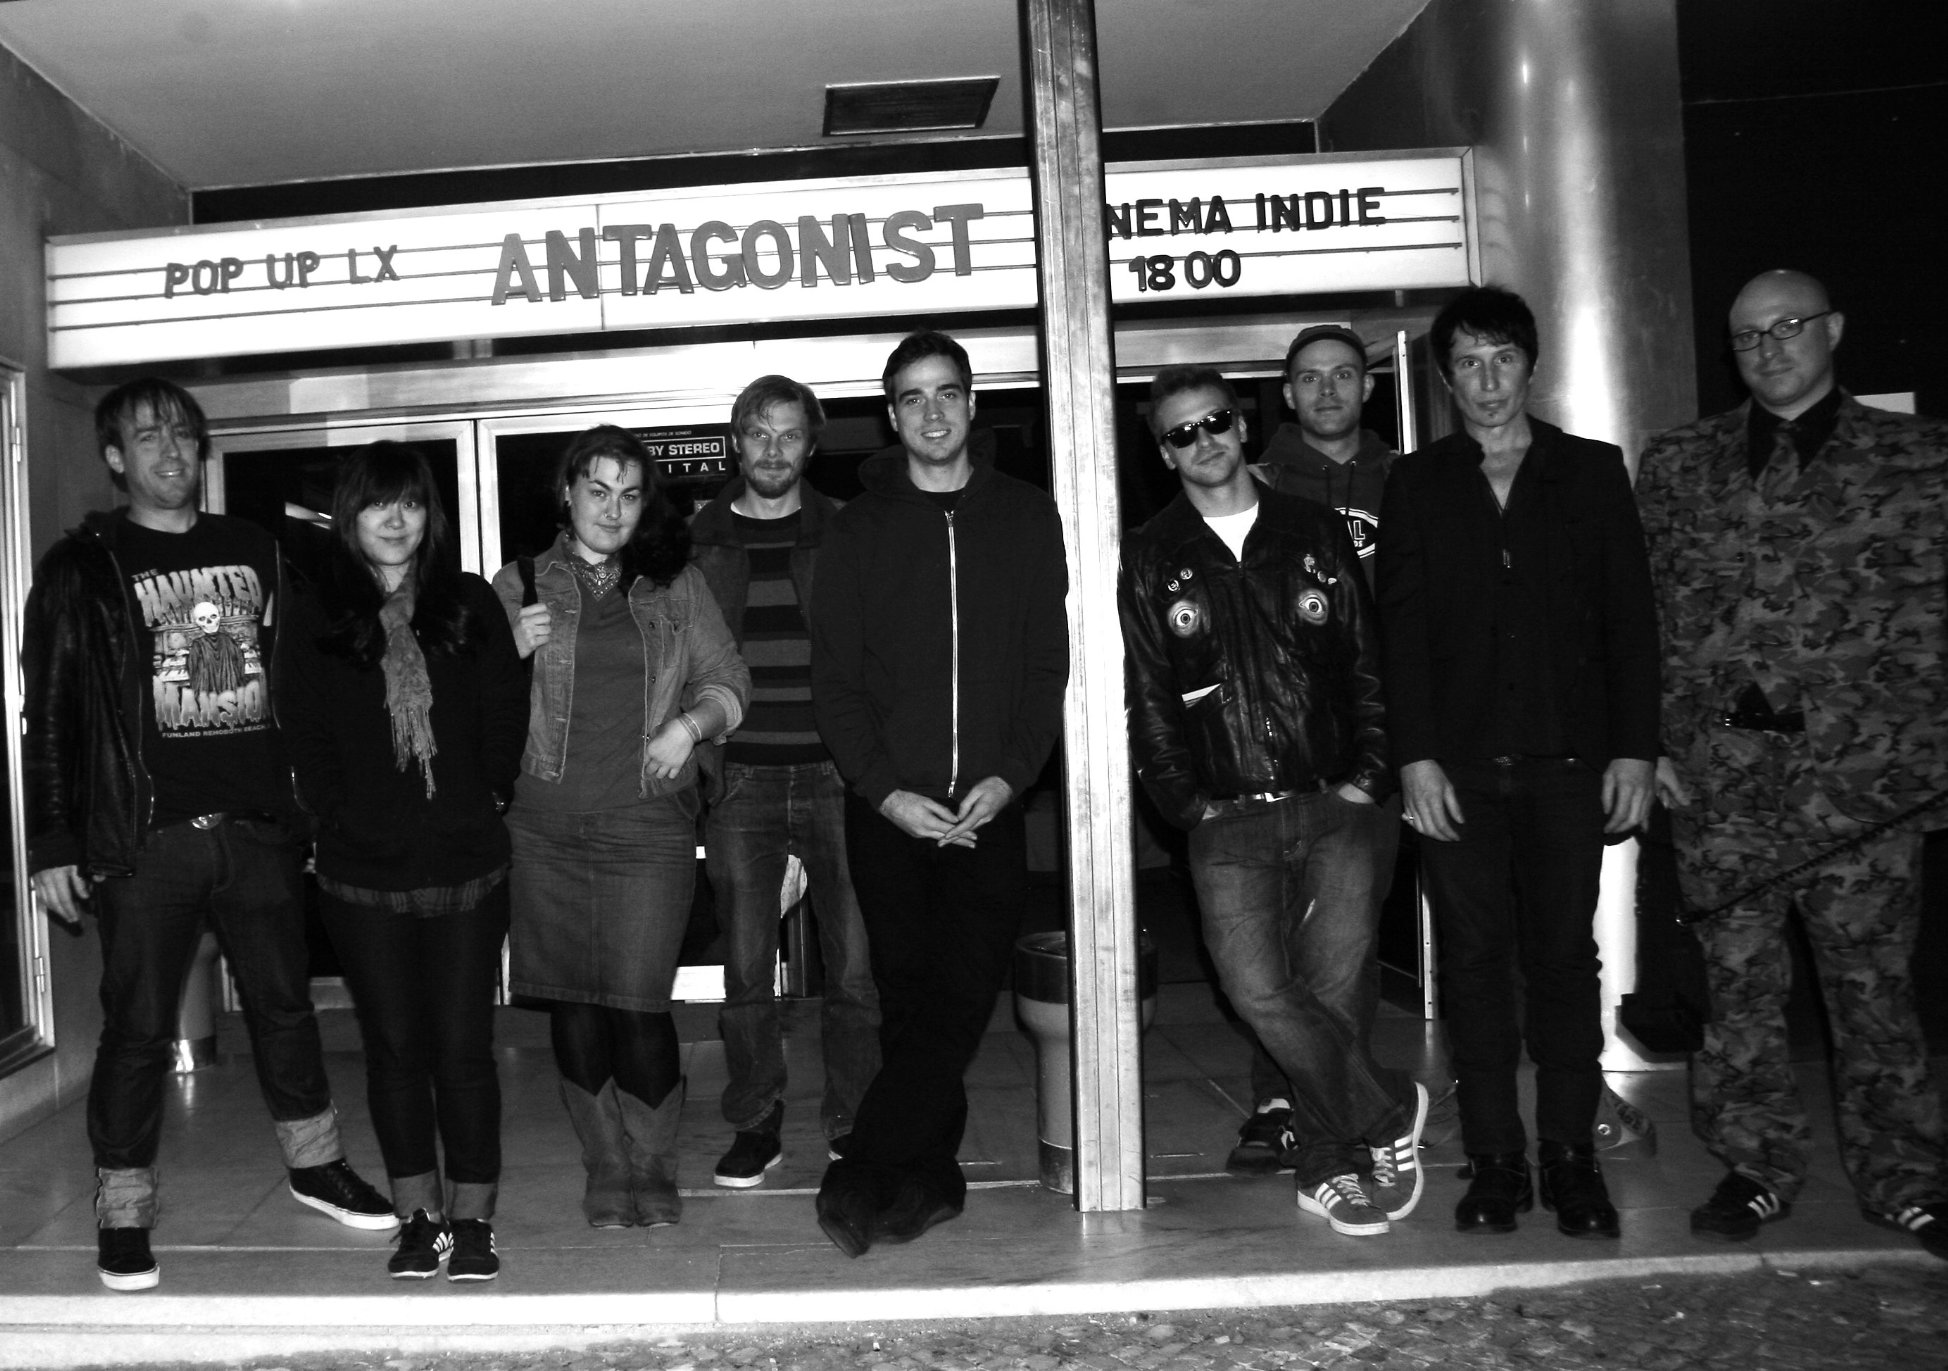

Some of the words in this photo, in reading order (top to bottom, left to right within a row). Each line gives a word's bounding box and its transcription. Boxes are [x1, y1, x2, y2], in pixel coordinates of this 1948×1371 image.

[1106, 195, 1233, 240] NEMA
[1255, 186, 1386, 234] INDIE
[164, 256, 244, 299] POP
[266, 250, 320, 290] UP
[348, 244, 398, 284] LX
[491, 202, 984, 306] ANTAGONIST
[668, 442, 720, 456] STEREO
[131, 568, 158, 581] THE
[134, 565, 263, 627] HAUNTED
